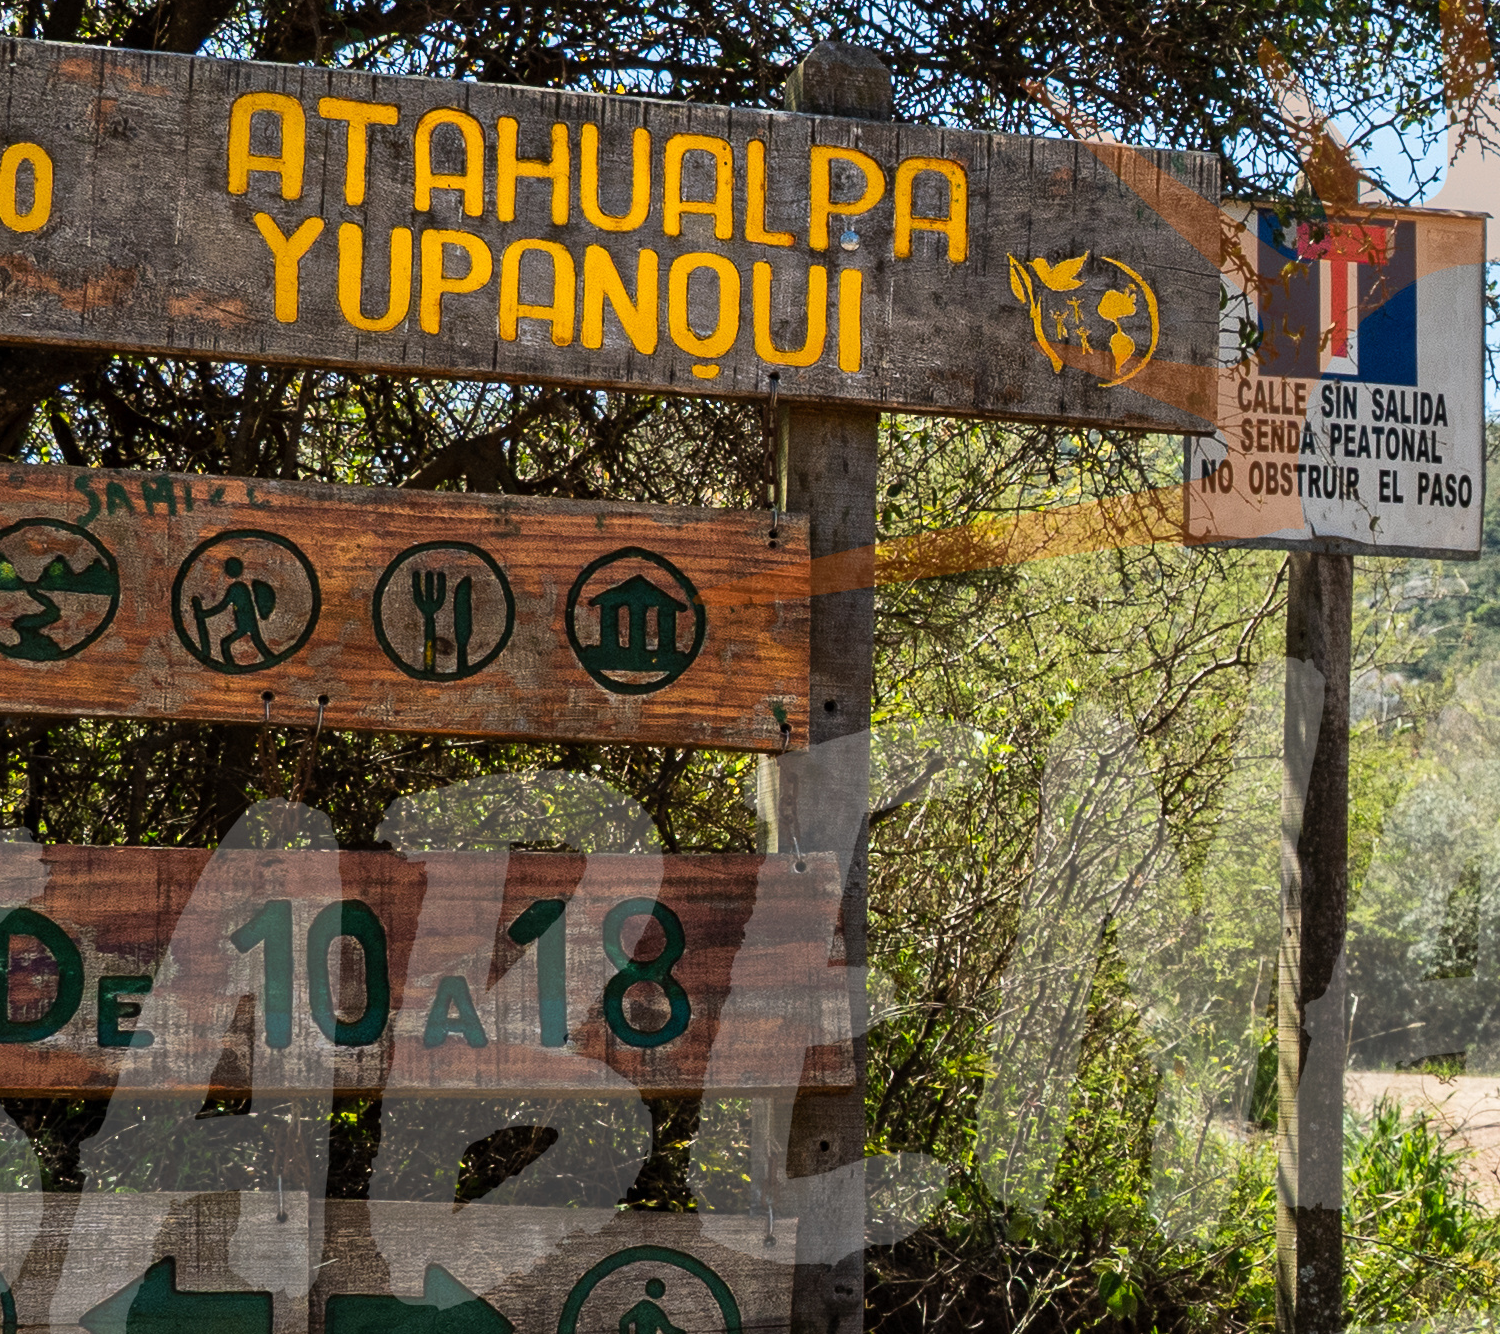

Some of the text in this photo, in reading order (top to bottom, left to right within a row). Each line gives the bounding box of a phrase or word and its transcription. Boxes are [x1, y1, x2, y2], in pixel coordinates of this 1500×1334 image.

[227, 91, 970, 264] ATAHUALPA
[252, 210, 864, 381] YUPANQUI
[1237, 378, 1448, 427] CALLE SIN SALIDA
[1241, 417, 1443, 464] SENDA PEATONAL
[1201, 459, 1472, 507] NO OBSTRUIR EL PASO
[230, 897, 389, 1049] 10
[423, 975, 488, 1048] A
[508, 895, 693, 1049] 18
